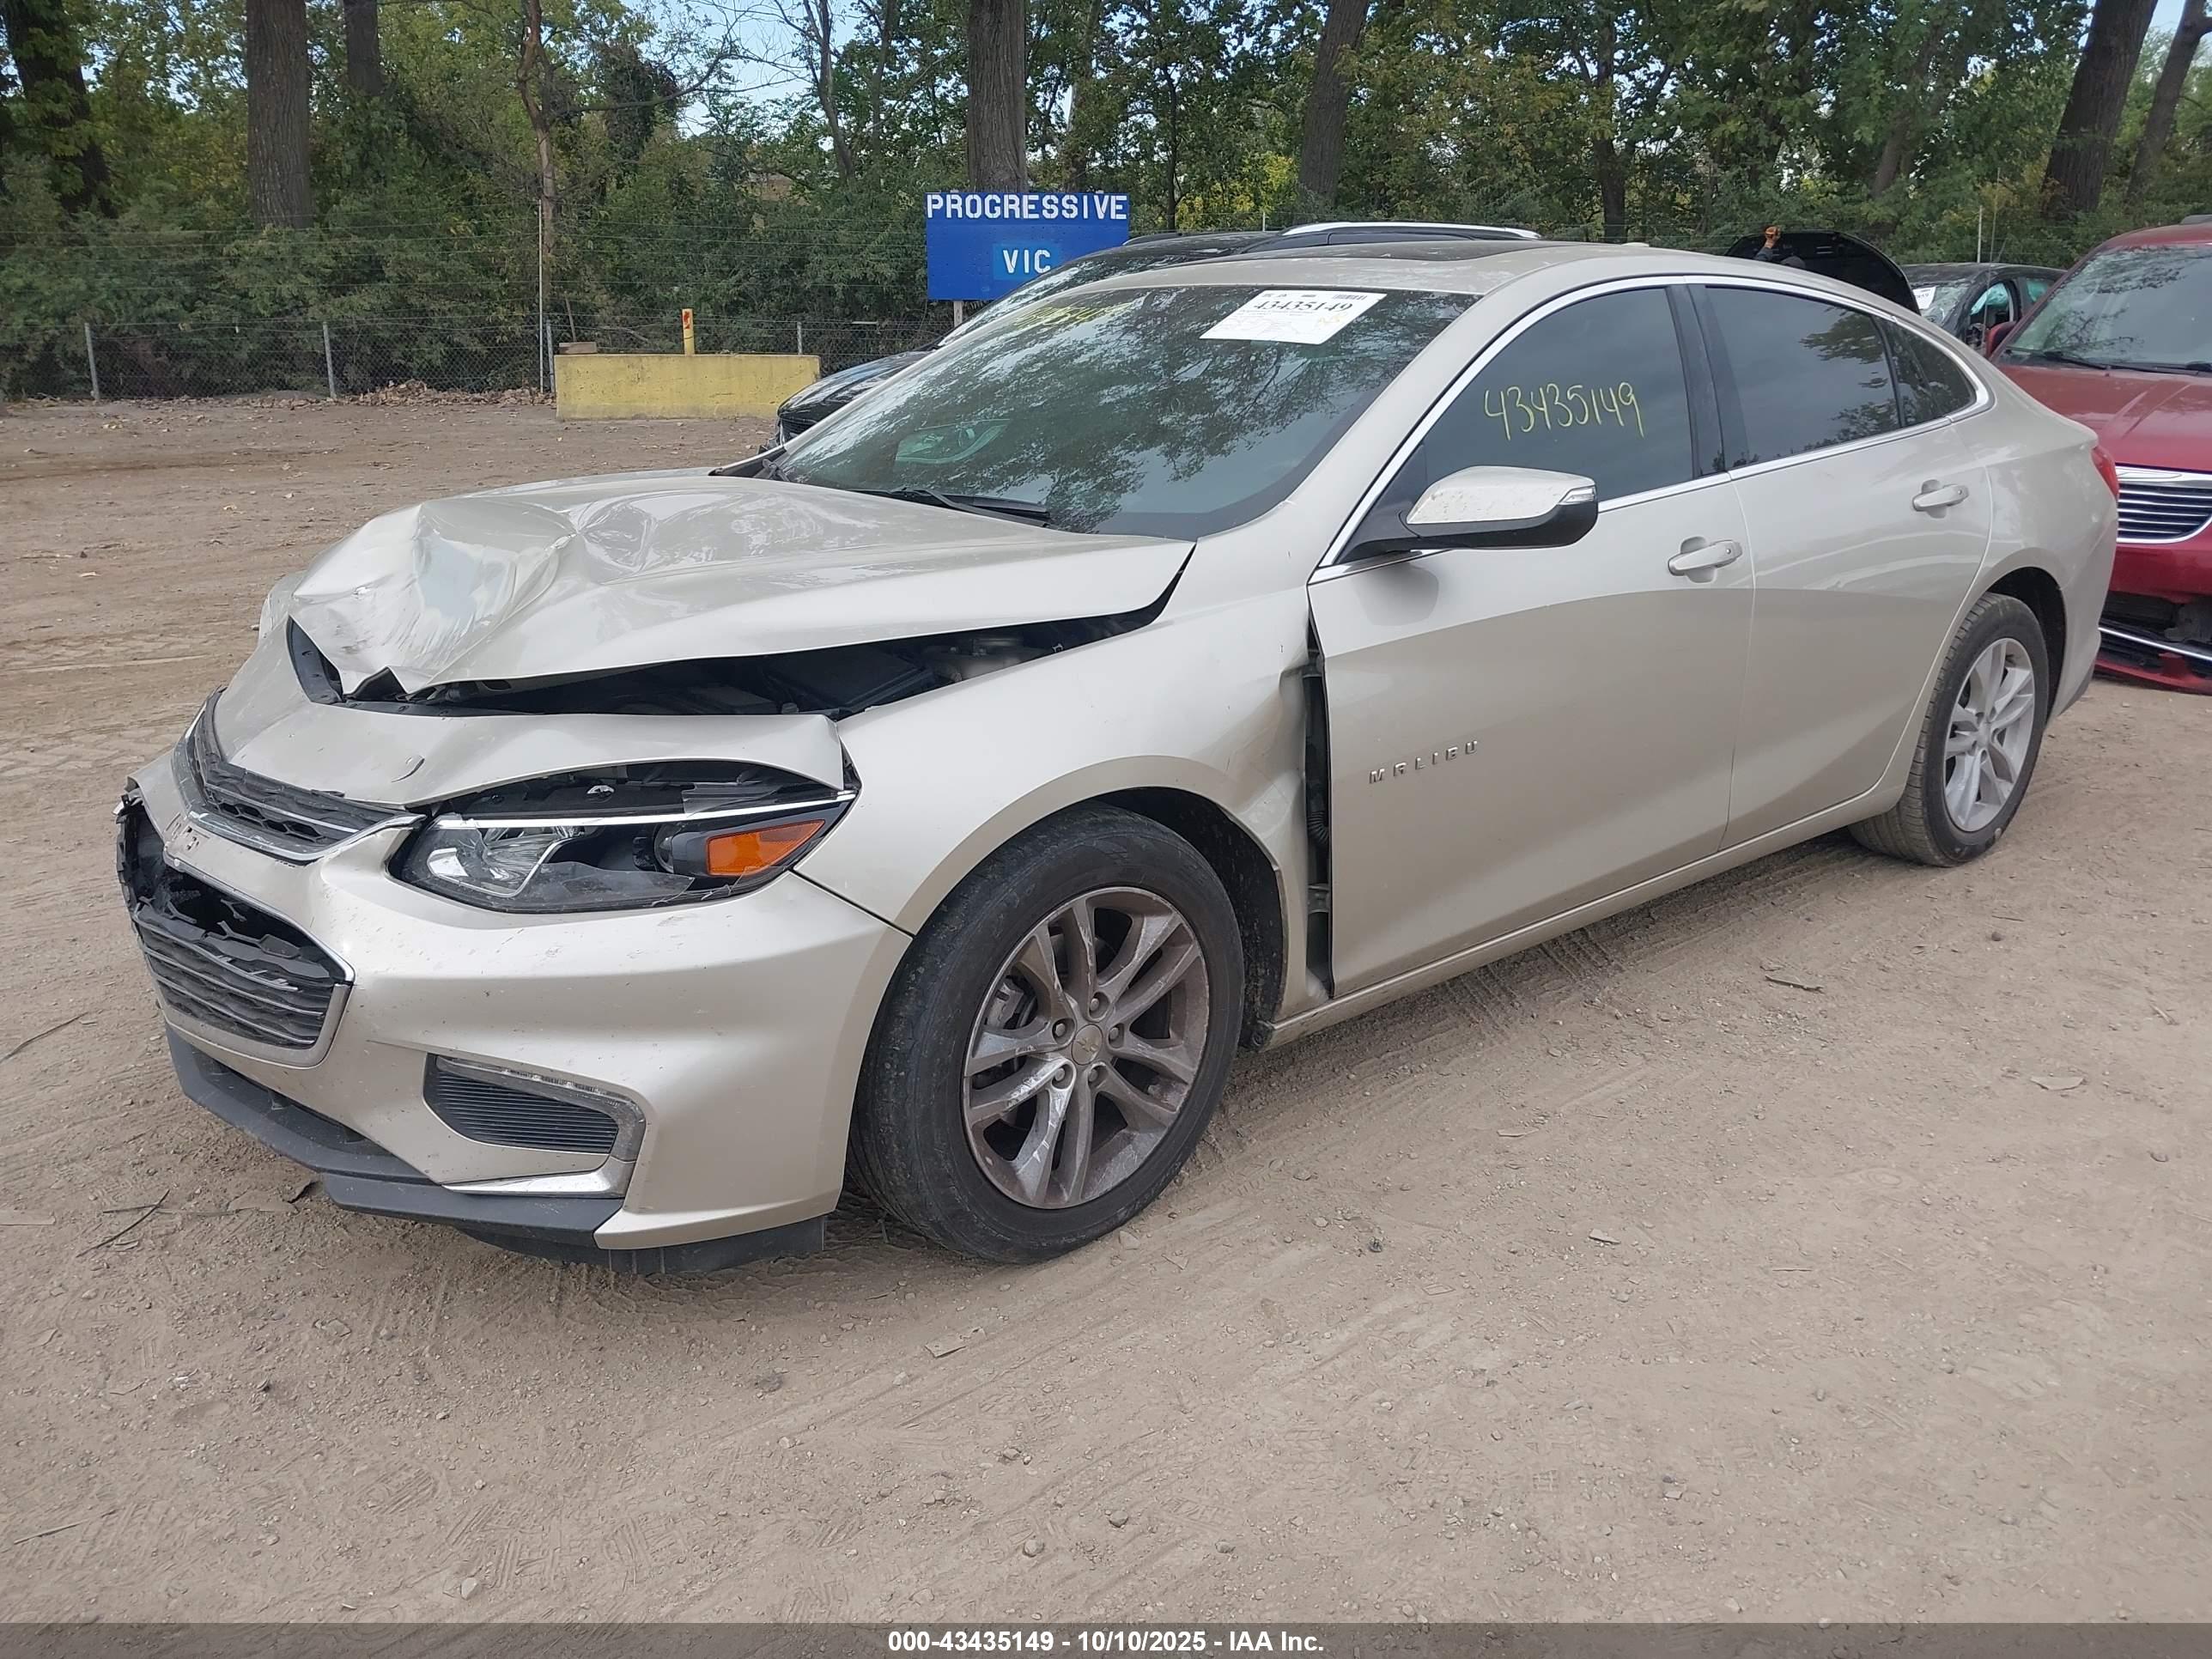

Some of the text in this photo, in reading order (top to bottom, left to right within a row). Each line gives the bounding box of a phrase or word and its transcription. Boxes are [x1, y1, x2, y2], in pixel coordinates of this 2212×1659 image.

[927, 194, 1127, 220] PROGRESSIVE
[1002, 249, 1052, 274] VIC
[1254, 301, 1353, 312] 43435149
[1484, 381, 1644, 441] 43435149
[1369, 740, 1478, 784] MALIBU
